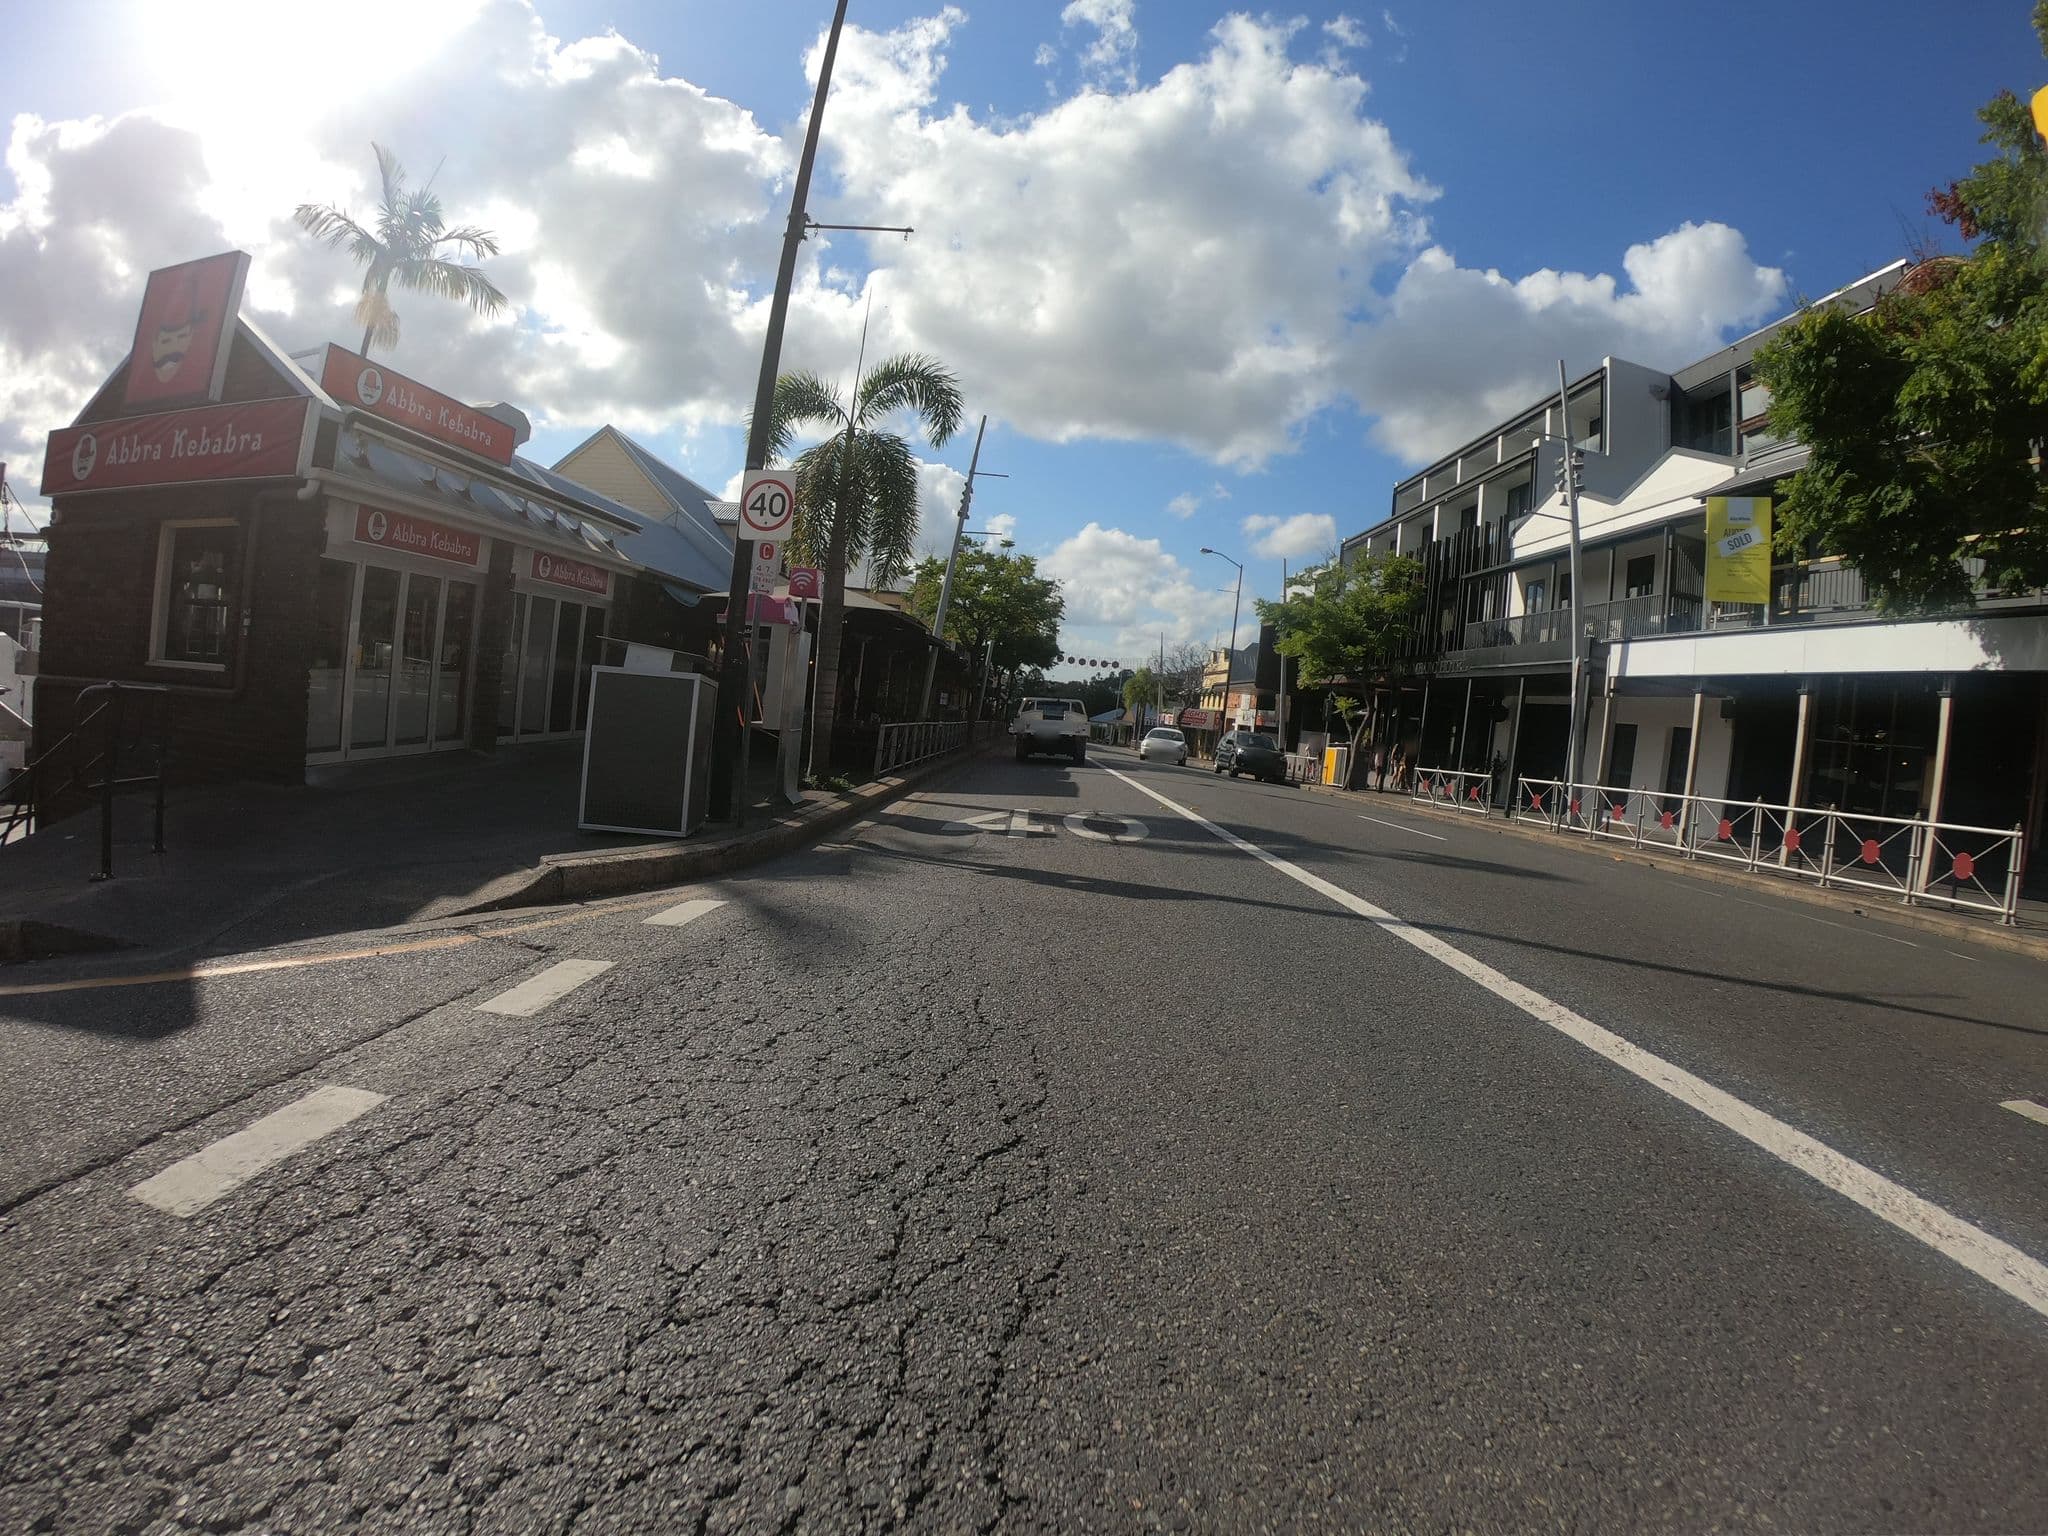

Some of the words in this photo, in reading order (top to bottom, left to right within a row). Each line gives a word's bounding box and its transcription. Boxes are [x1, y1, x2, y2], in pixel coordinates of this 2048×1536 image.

[386, 385, 432, 420] Abbra
[438, 405, 492, 446] Kebabra
[105, 434, 162, 464] Abbra
[170, 423, 263, 458] Kebabra
[748, 492, 786, 517] 40
[392, 522, 426, 546] Abbra
[430, 529, 471, 557] Kebabra
[1727, 532, 1752, 551] SOLD
[941, 808, 1150, 842] 40
